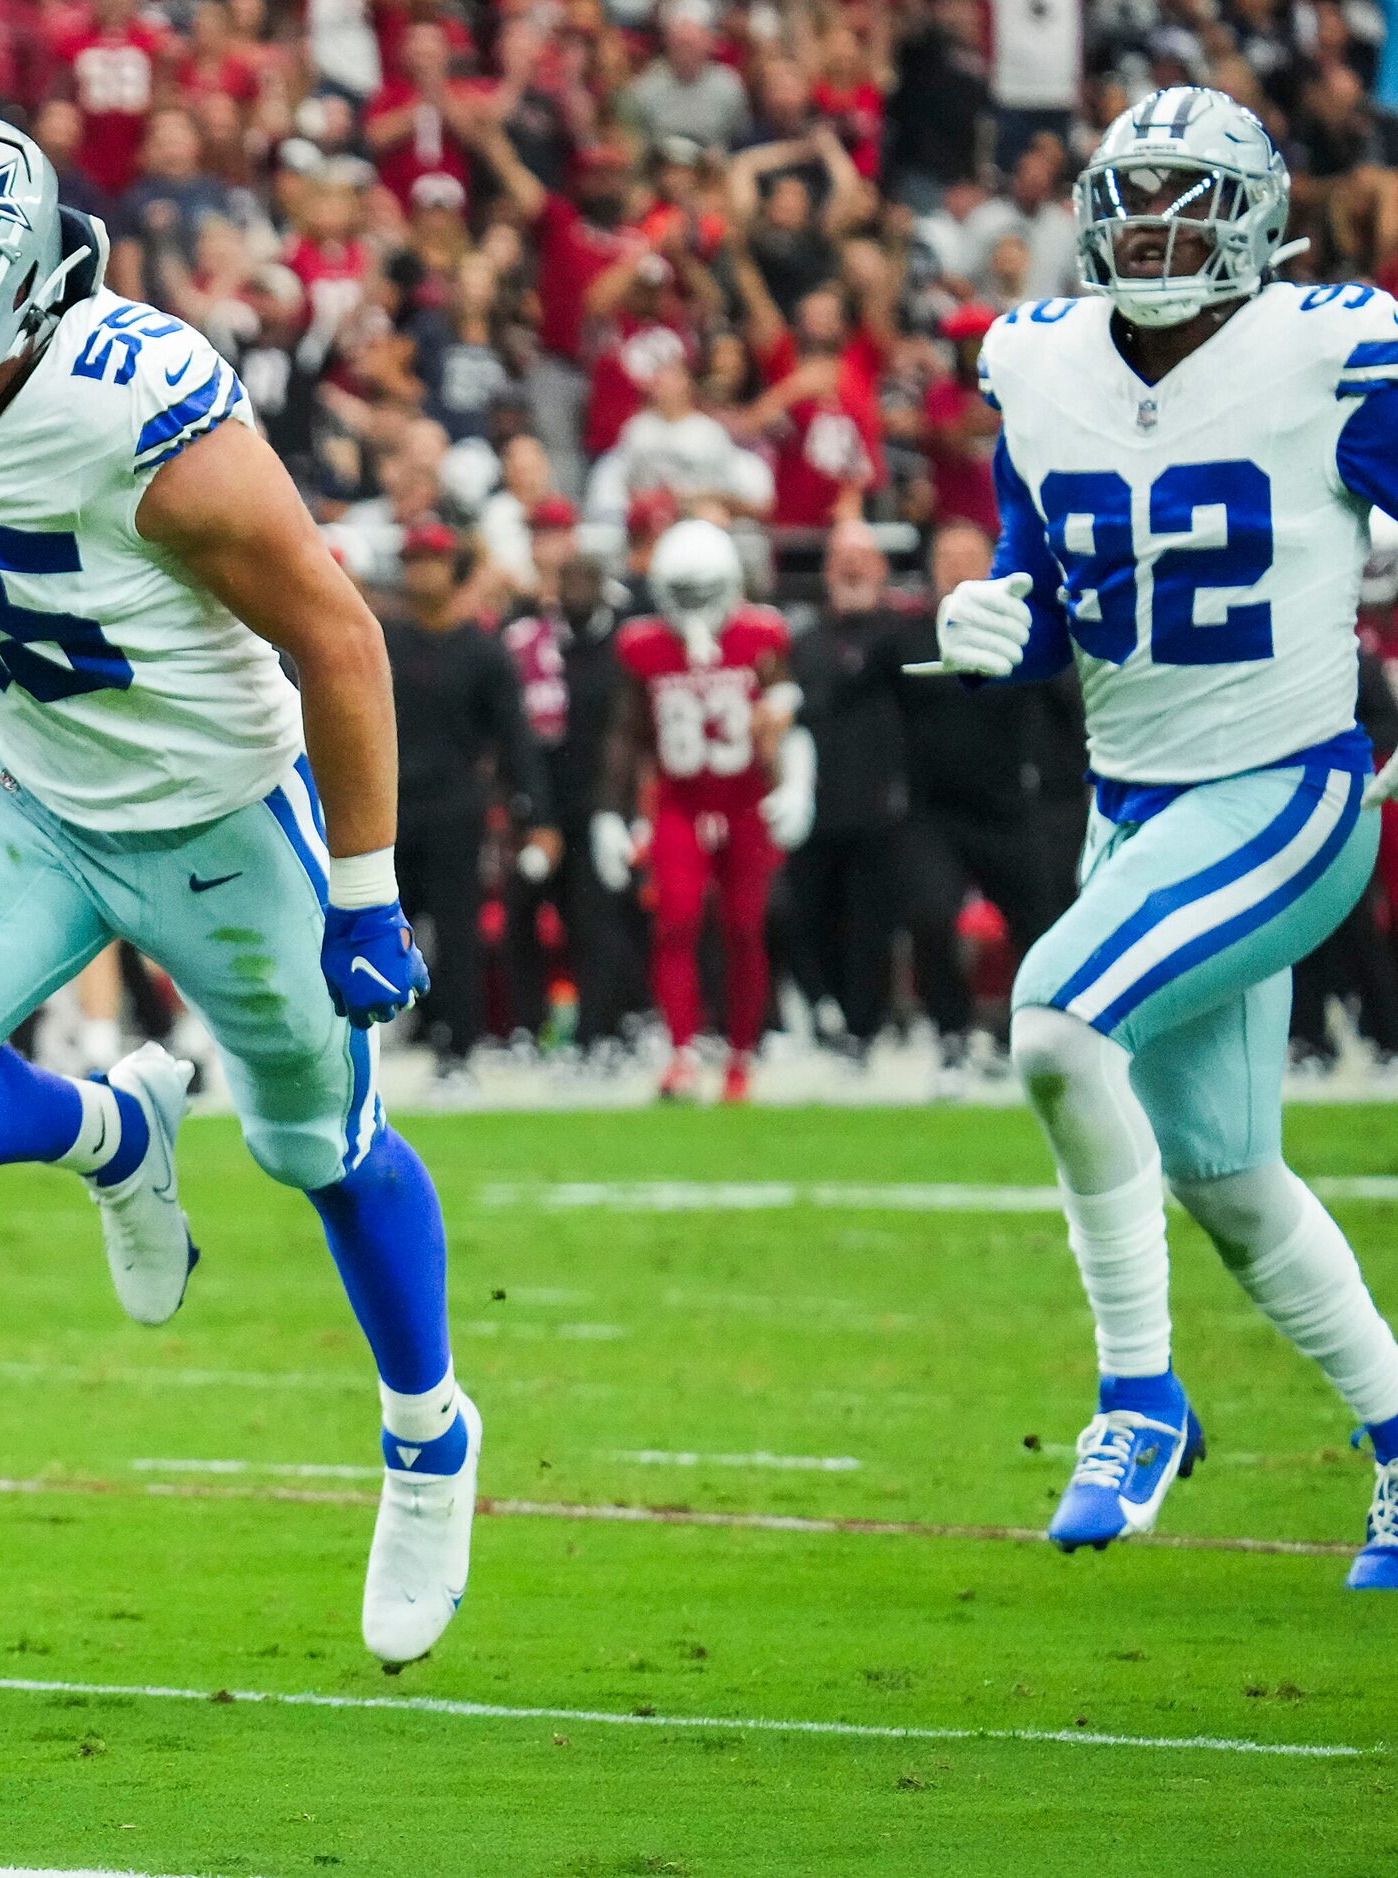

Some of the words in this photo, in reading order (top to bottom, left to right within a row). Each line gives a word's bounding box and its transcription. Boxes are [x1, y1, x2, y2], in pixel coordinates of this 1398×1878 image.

[70, 305, 184, 385] 55
[1039, 458, 1275, 666] 92
[656, 684, 754, 777] 83
